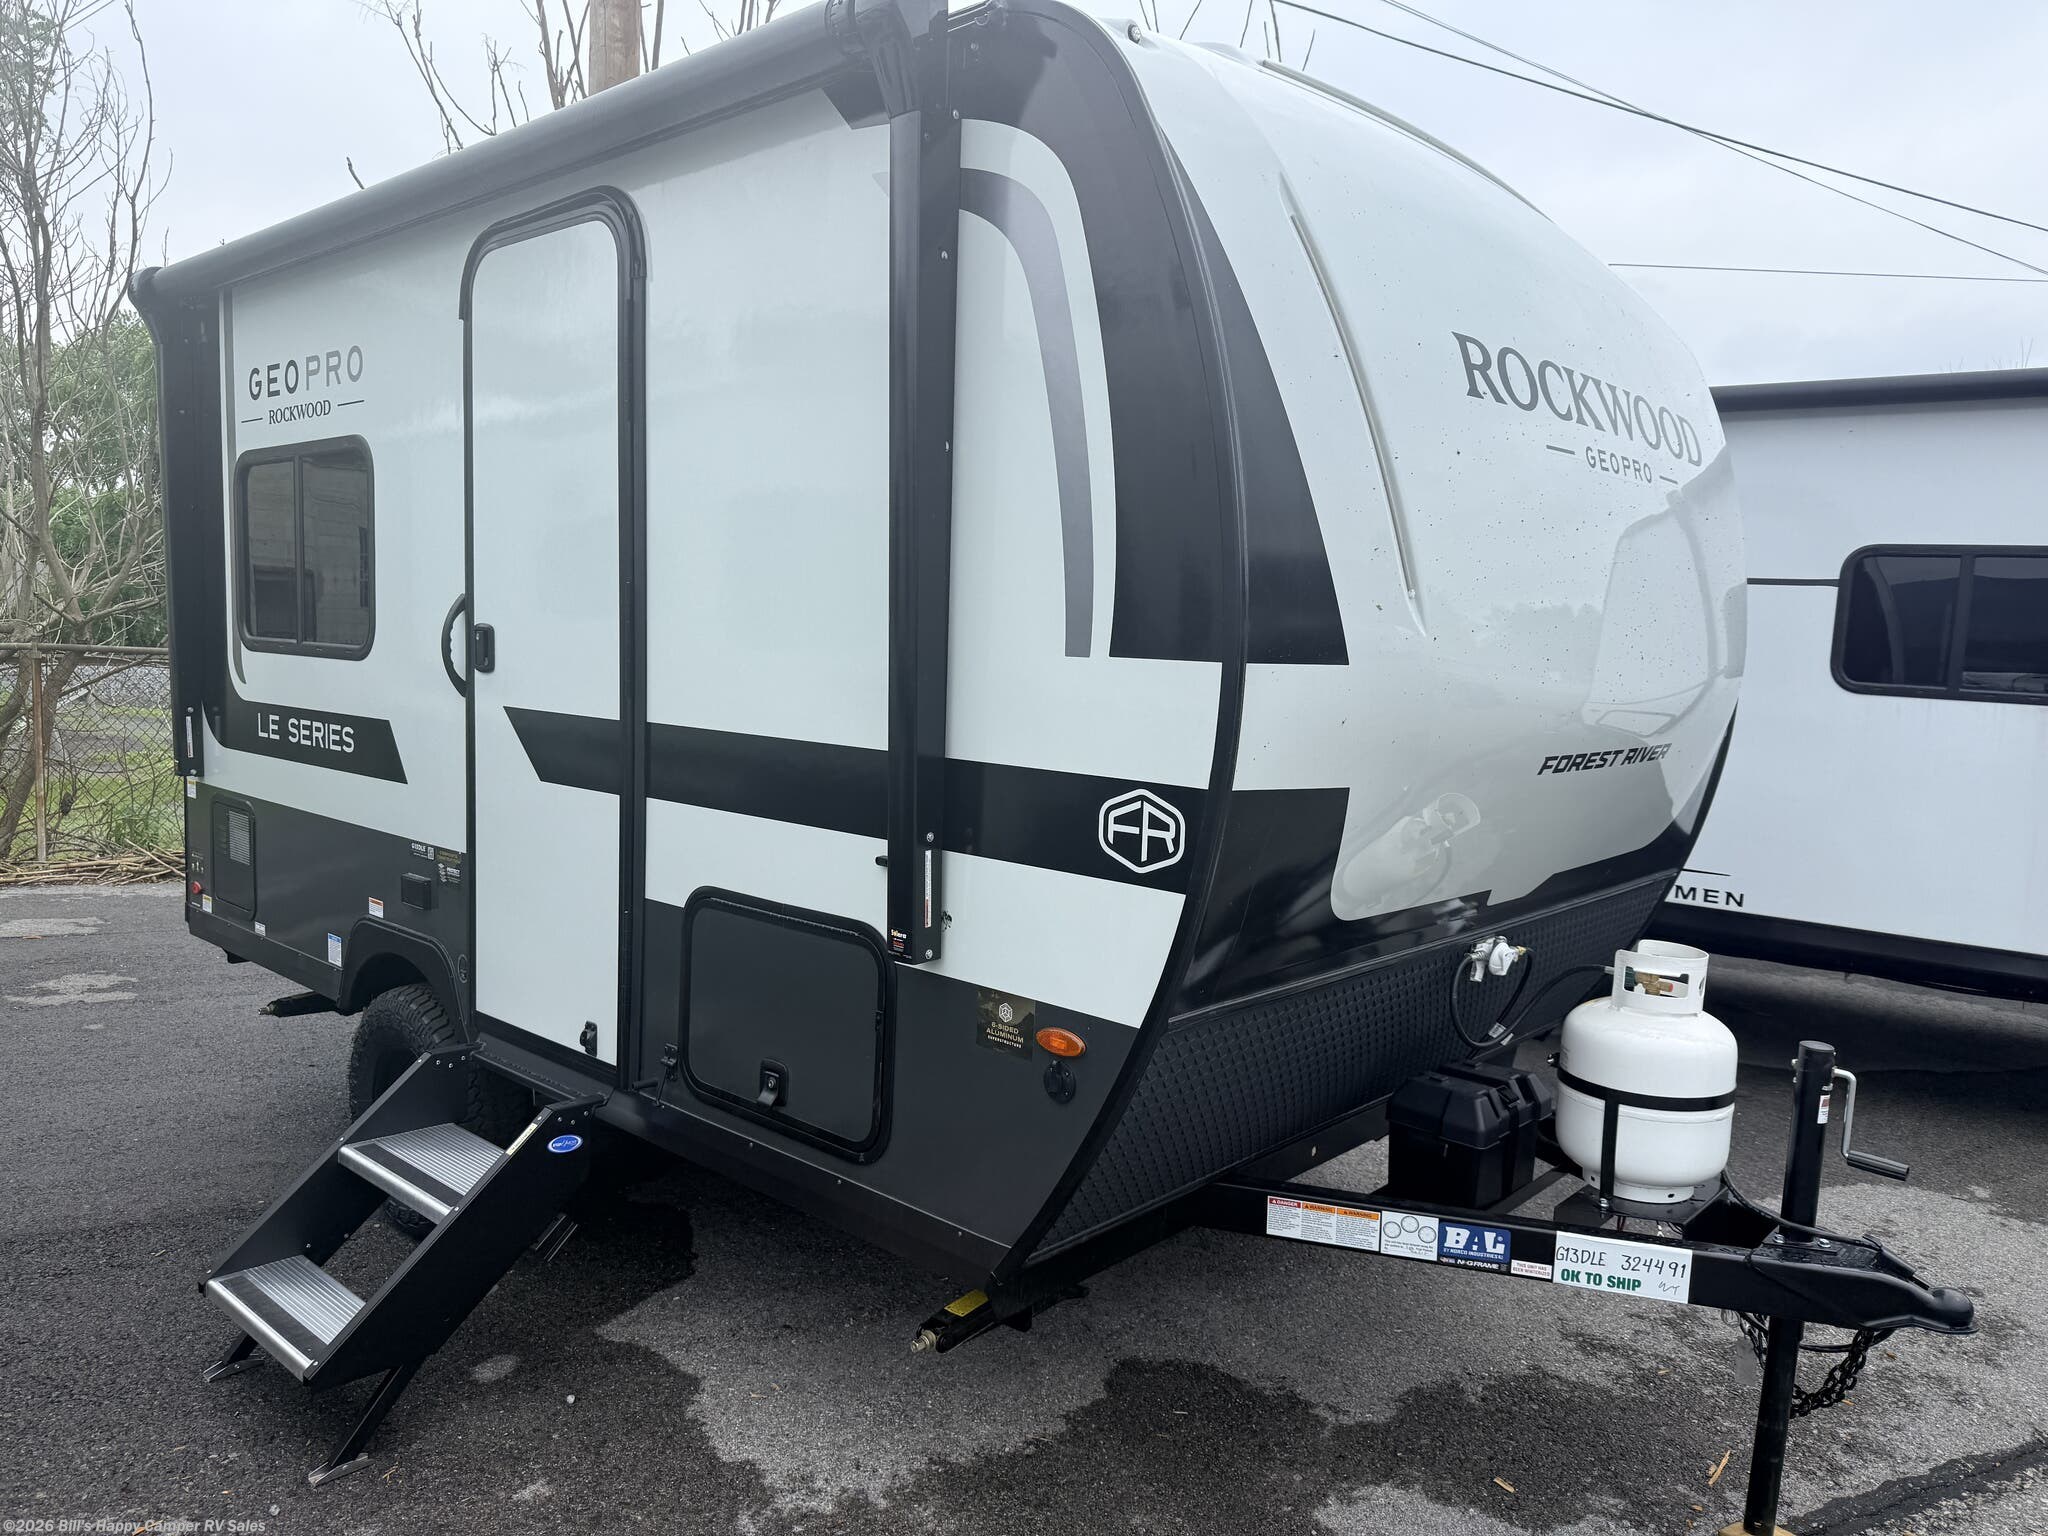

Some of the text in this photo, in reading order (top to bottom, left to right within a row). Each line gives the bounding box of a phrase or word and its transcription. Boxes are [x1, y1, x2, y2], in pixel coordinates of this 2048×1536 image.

[248, 344, 364, 401] GEOPRO
[268, 400, 332, 425] ROCKWOOD
[1452, 331, 1703, 467] ROCKWOOD
[1585, 446, 1653, 484] GEOPRO
[257, 712, 355, 754] LE SERIES
[1538, 743, 1672, 775] FOREST RIVER
[1675, 884, 1744, 907] MEN
[986, 1027, 1024, 1043] ALUMINUM
[1444, 1226, 1506, 1255] BAL
[1555, 1245, 1687, 1279] G13DLE 324491
[1561, 1268, 1641, 1291] OK TO SHIP
